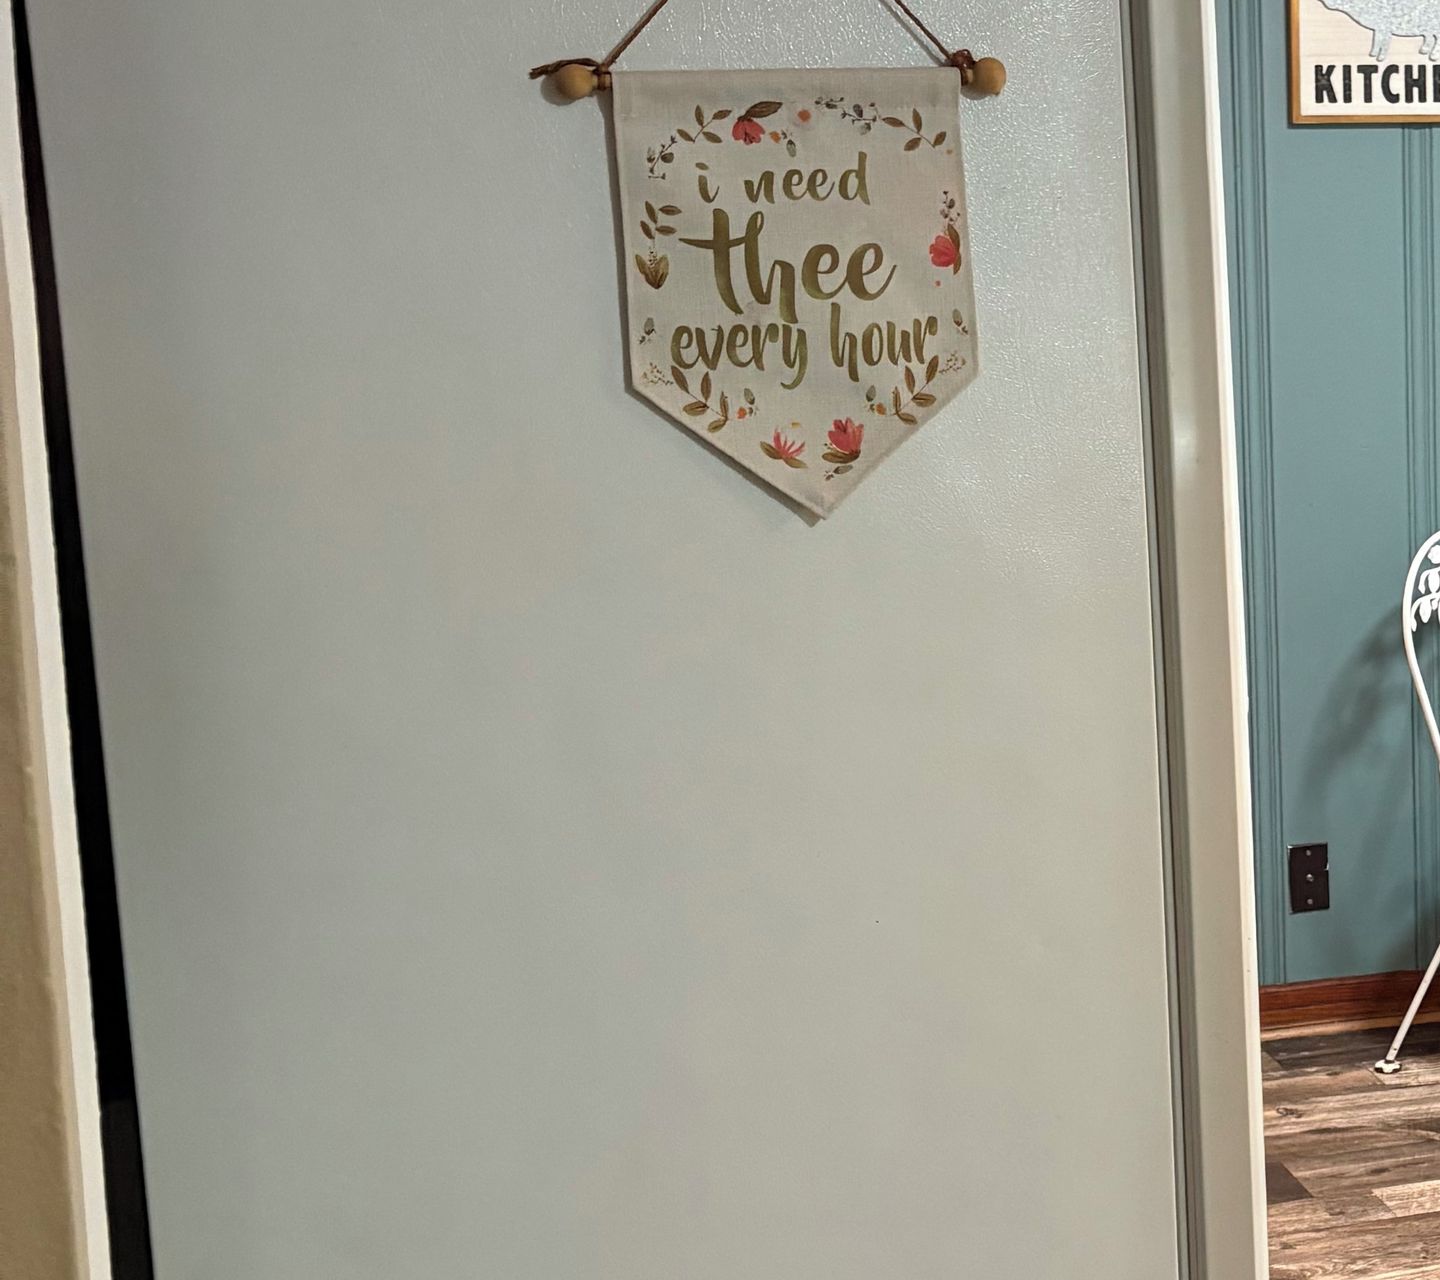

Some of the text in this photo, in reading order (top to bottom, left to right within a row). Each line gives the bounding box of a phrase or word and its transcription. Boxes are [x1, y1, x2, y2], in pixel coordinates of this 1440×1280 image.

[695, 151, 871, 205] i need
[678, 208, 897, 323] thee
[670, 302, 938, 390] every hour
